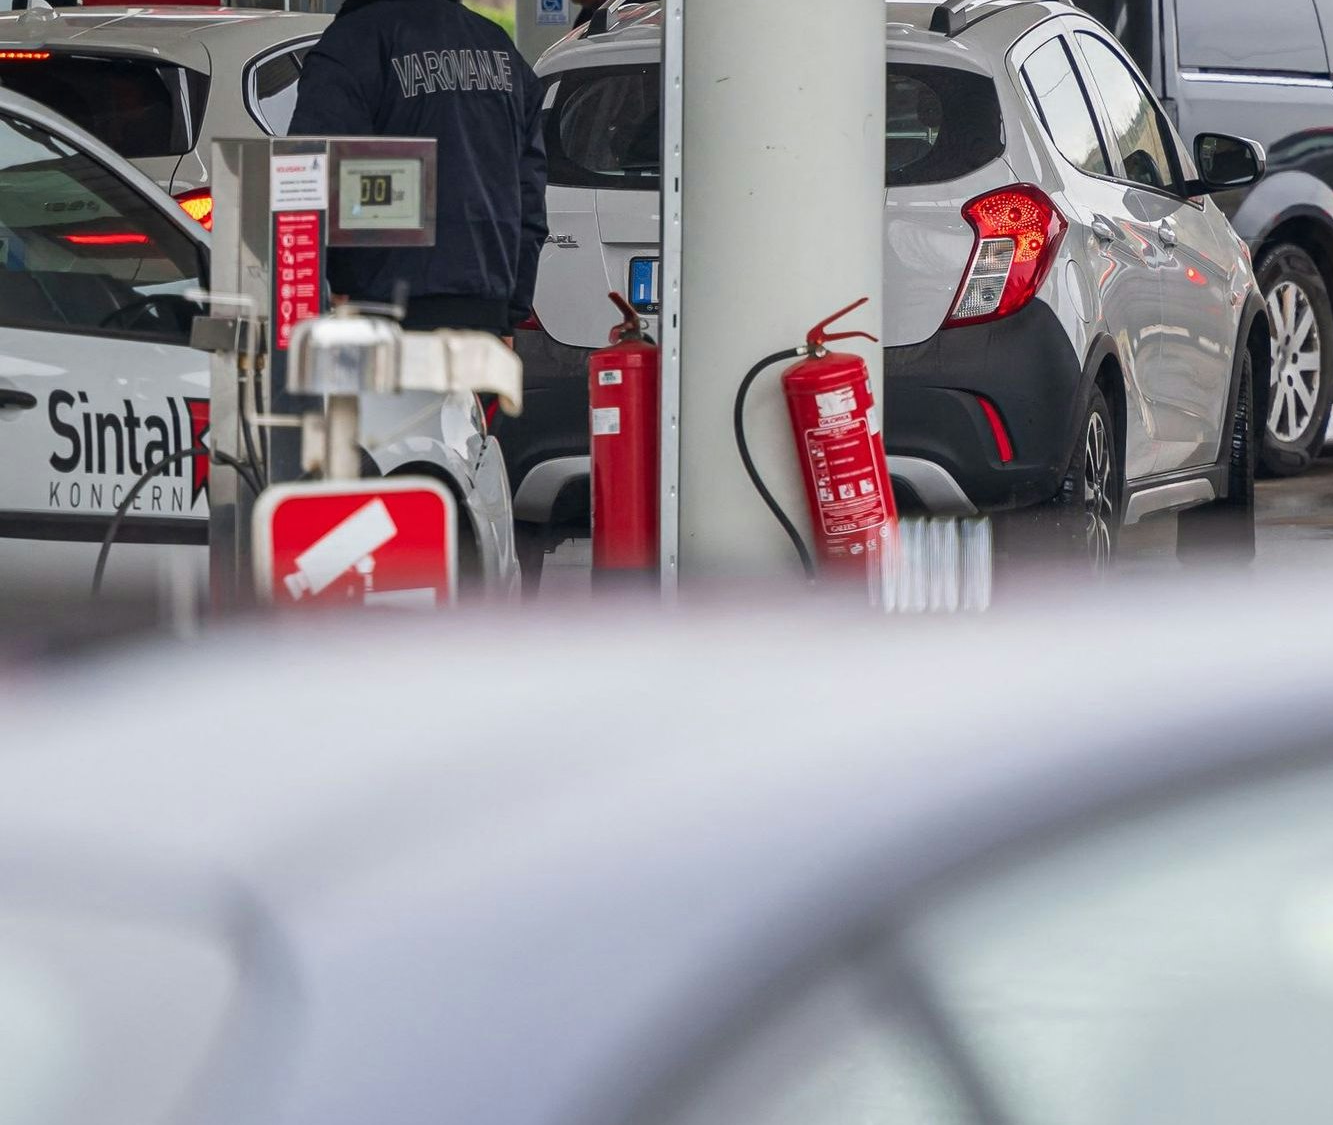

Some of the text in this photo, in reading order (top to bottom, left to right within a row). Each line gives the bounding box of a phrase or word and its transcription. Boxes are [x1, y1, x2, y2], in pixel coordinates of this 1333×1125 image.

[391, 49, 513, 98] VAROVANJE
[543, 235, 578, 243] ARL
[48, 389, 183, 477] Sintal
